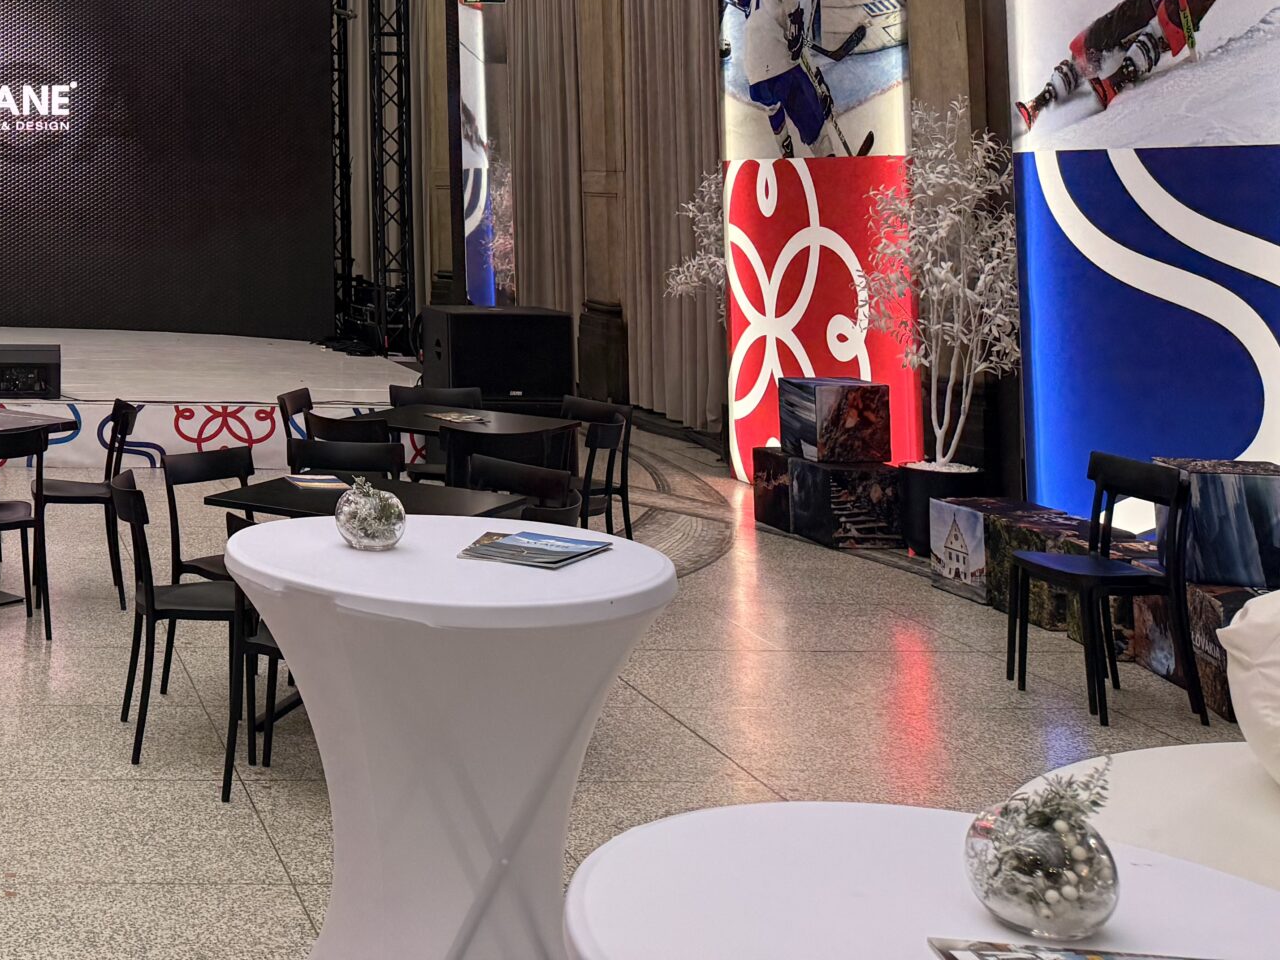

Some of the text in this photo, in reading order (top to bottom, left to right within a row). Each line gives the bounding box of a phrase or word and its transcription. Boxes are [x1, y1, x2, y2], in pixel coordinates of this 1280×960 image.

[1, 121, 11, 131] &
[16, 121, 70, 131] DESIGN
[1191, 630, 1221, 660] LOVAKIA
